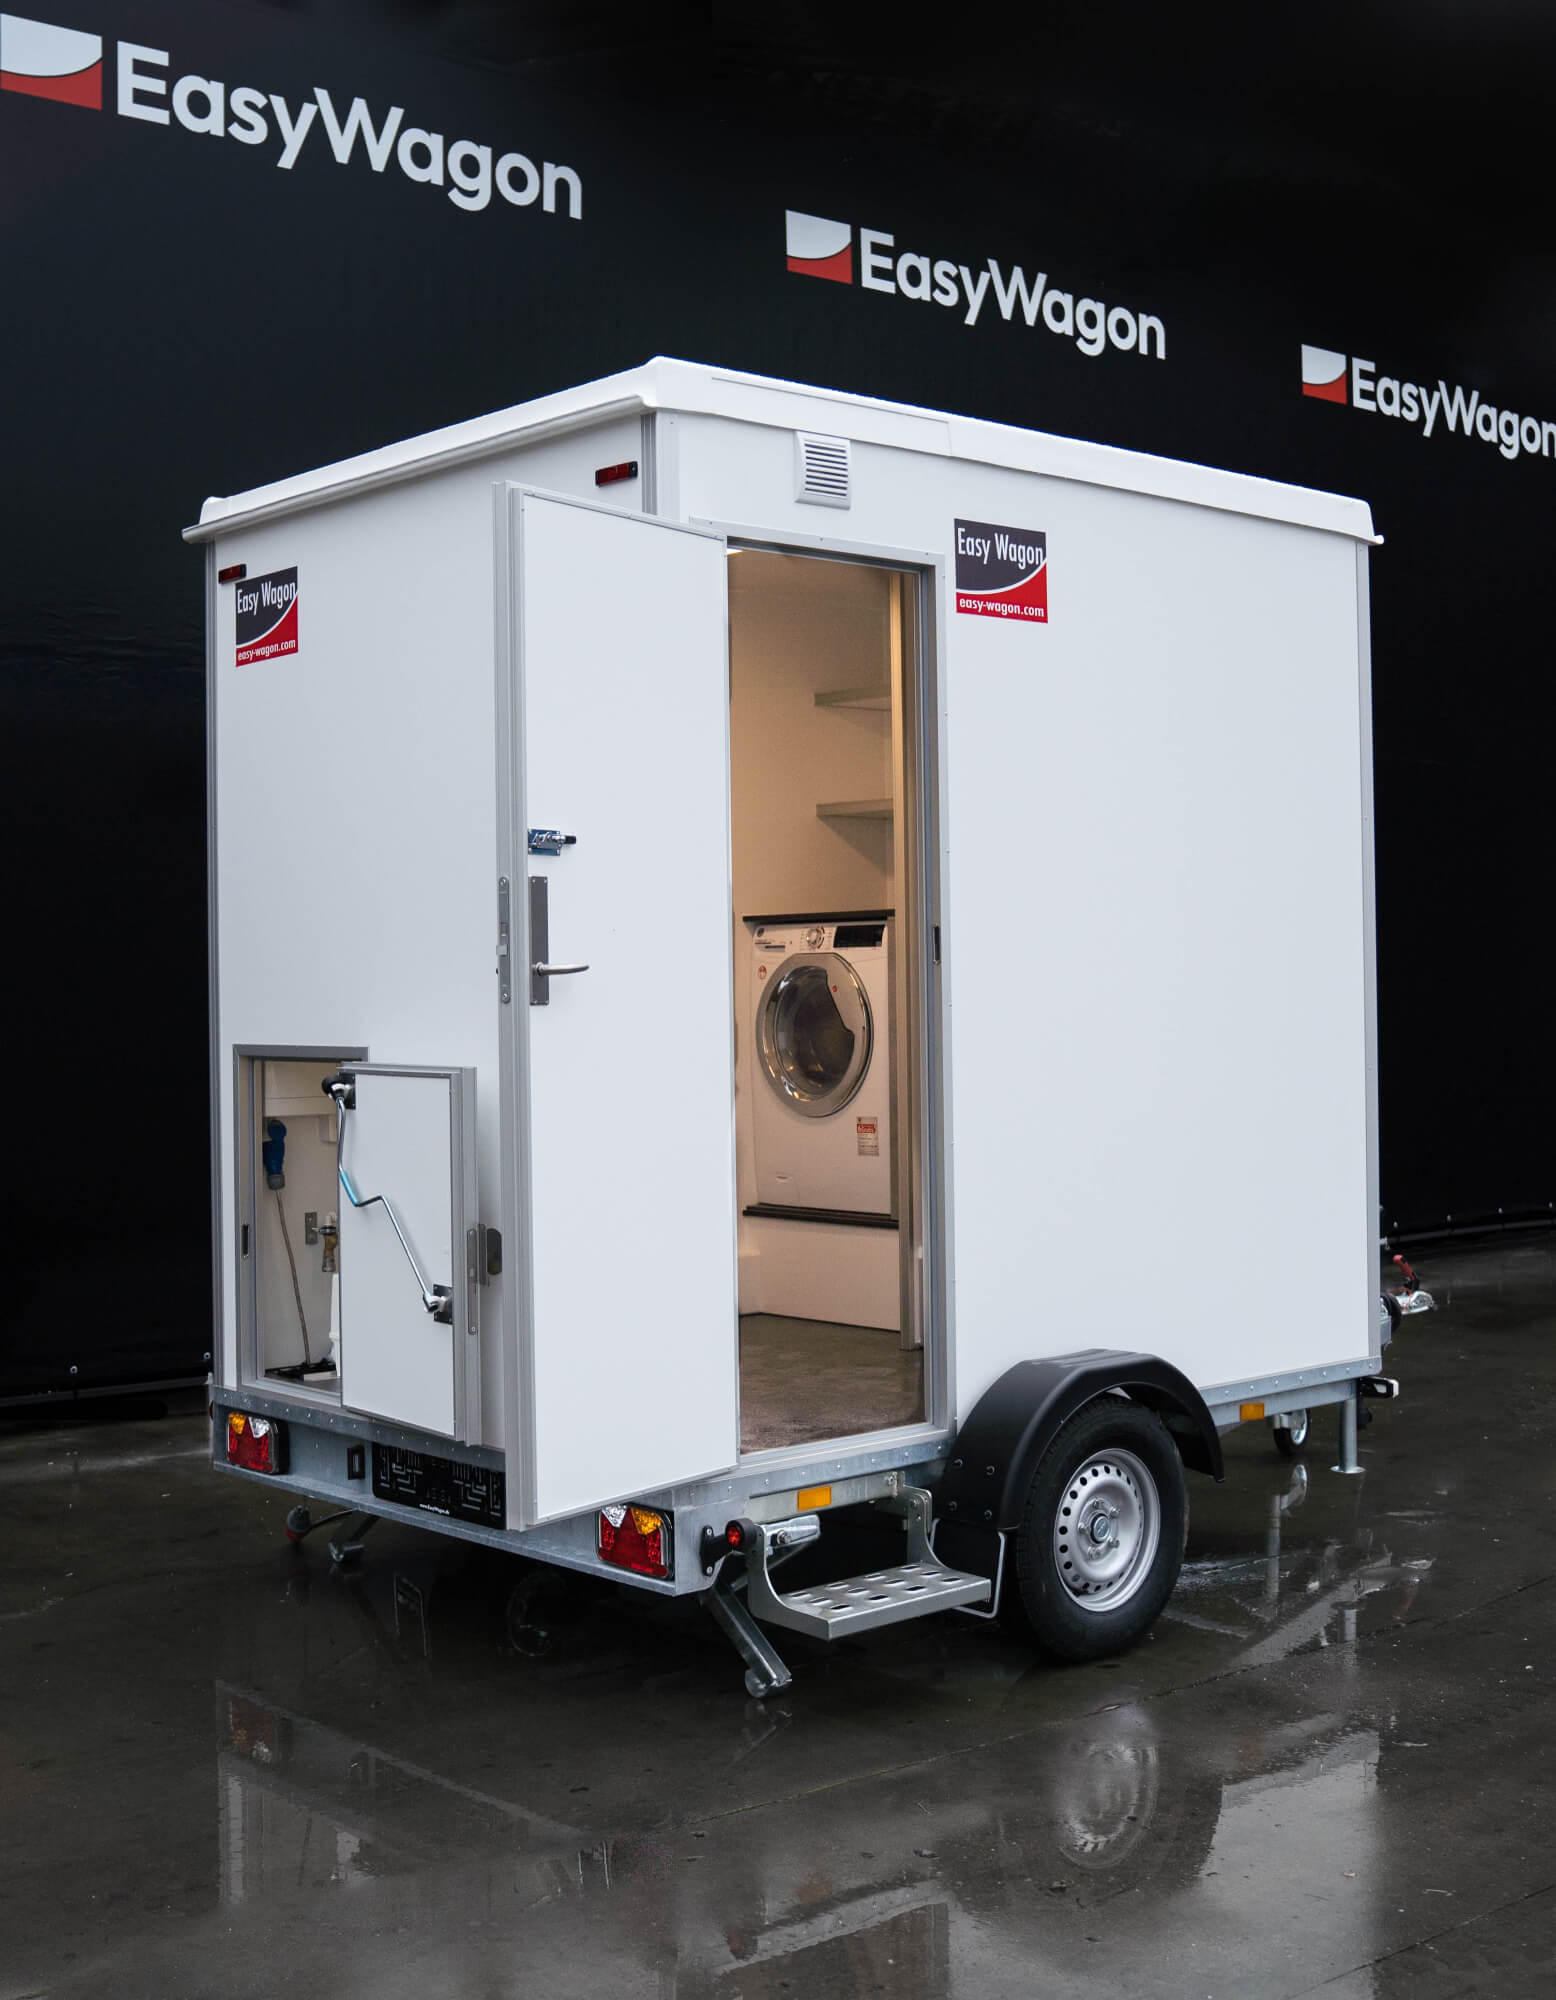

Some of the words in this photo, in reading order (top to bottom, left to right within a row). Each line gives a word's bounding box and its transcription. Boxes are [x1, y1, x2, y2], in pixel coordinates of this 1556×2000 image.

[117, 41, 582, 220] EasyWagon
[861, 228, 1166, 360] EasyWagon
[957, 527, 991, 565] Easy
[994, 532, 1043, 570] Wagon
[237, 589, 259, 616] Easy
[261, 580, 296, 609] Wagon
[959, 598, 1044, 617] easy-wagon.com
[237, 639, 296, 661] easy-wagon.com
